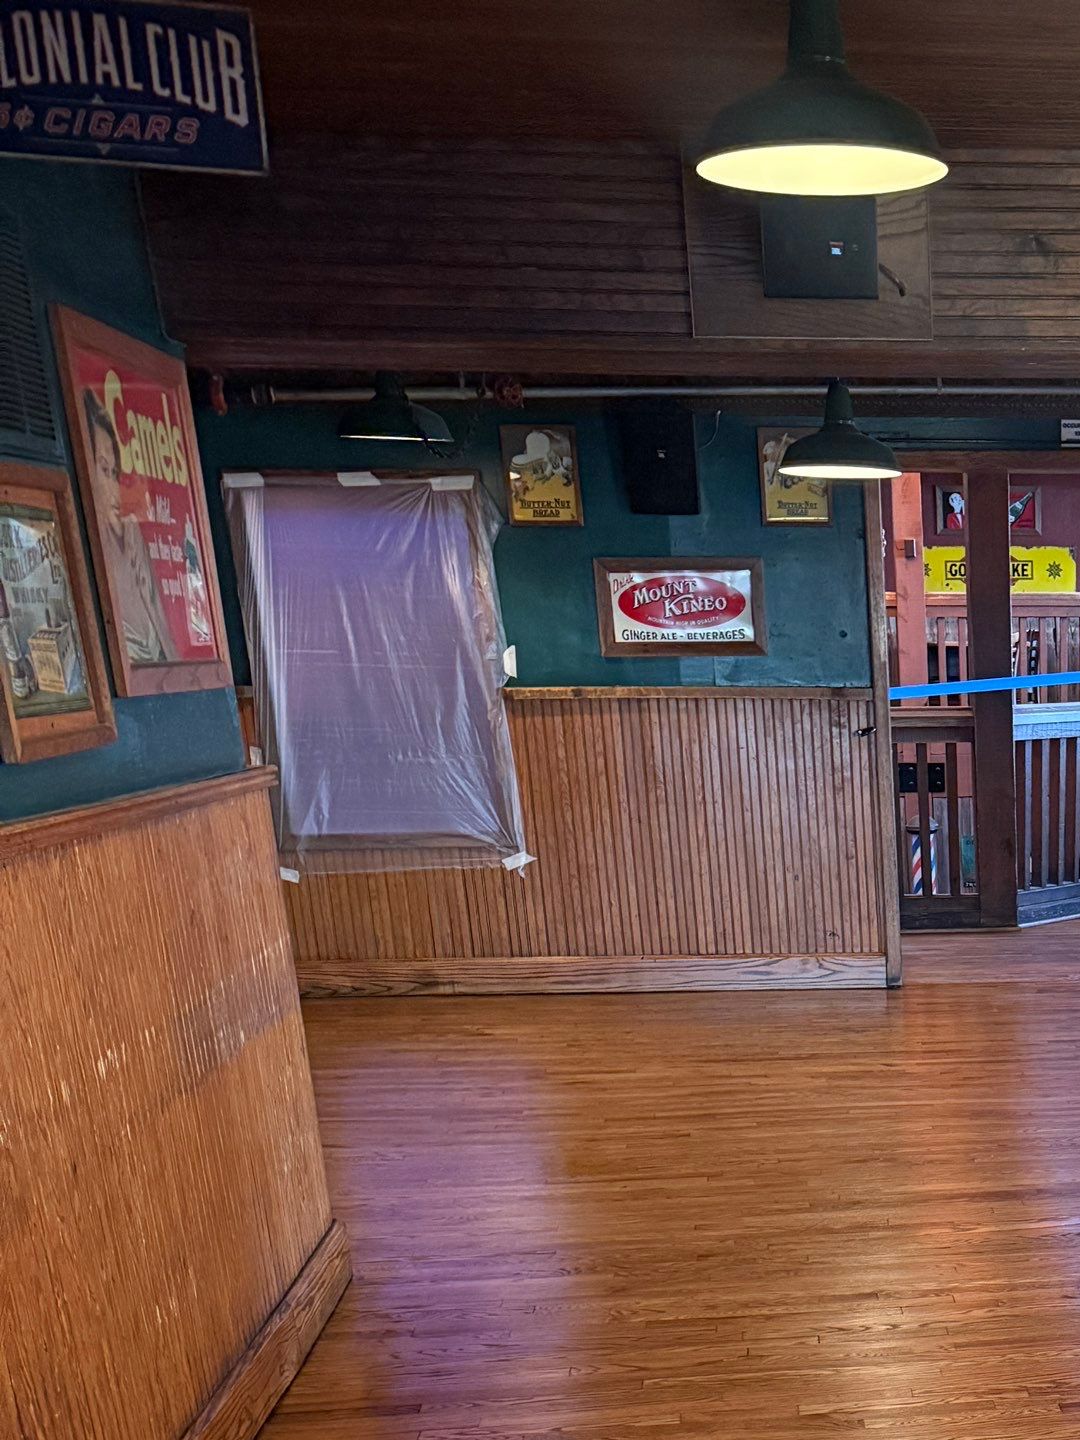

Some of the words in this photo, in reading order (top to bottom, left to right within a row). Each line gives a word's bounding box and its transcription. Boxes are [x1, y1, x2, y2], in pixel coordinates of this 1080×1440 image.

[145, 22, 250, 128] CLUB
[44, 106, 201, 145] CIGARS
[104, 369, 187, 487] Camels
[533, 508, 561, 516] BREAD
[612, 574, 635, 594] Drink
[632, 579, 697, 609] MOUNT
[664, 595, 727, 618] KINEO
[696, 616, 719, 626] QUALITY
[621, 628, 658, 641] GINGER
[660, 632, 678, 641] ALE
[687, 628, 746, 641] BEVERAGES
